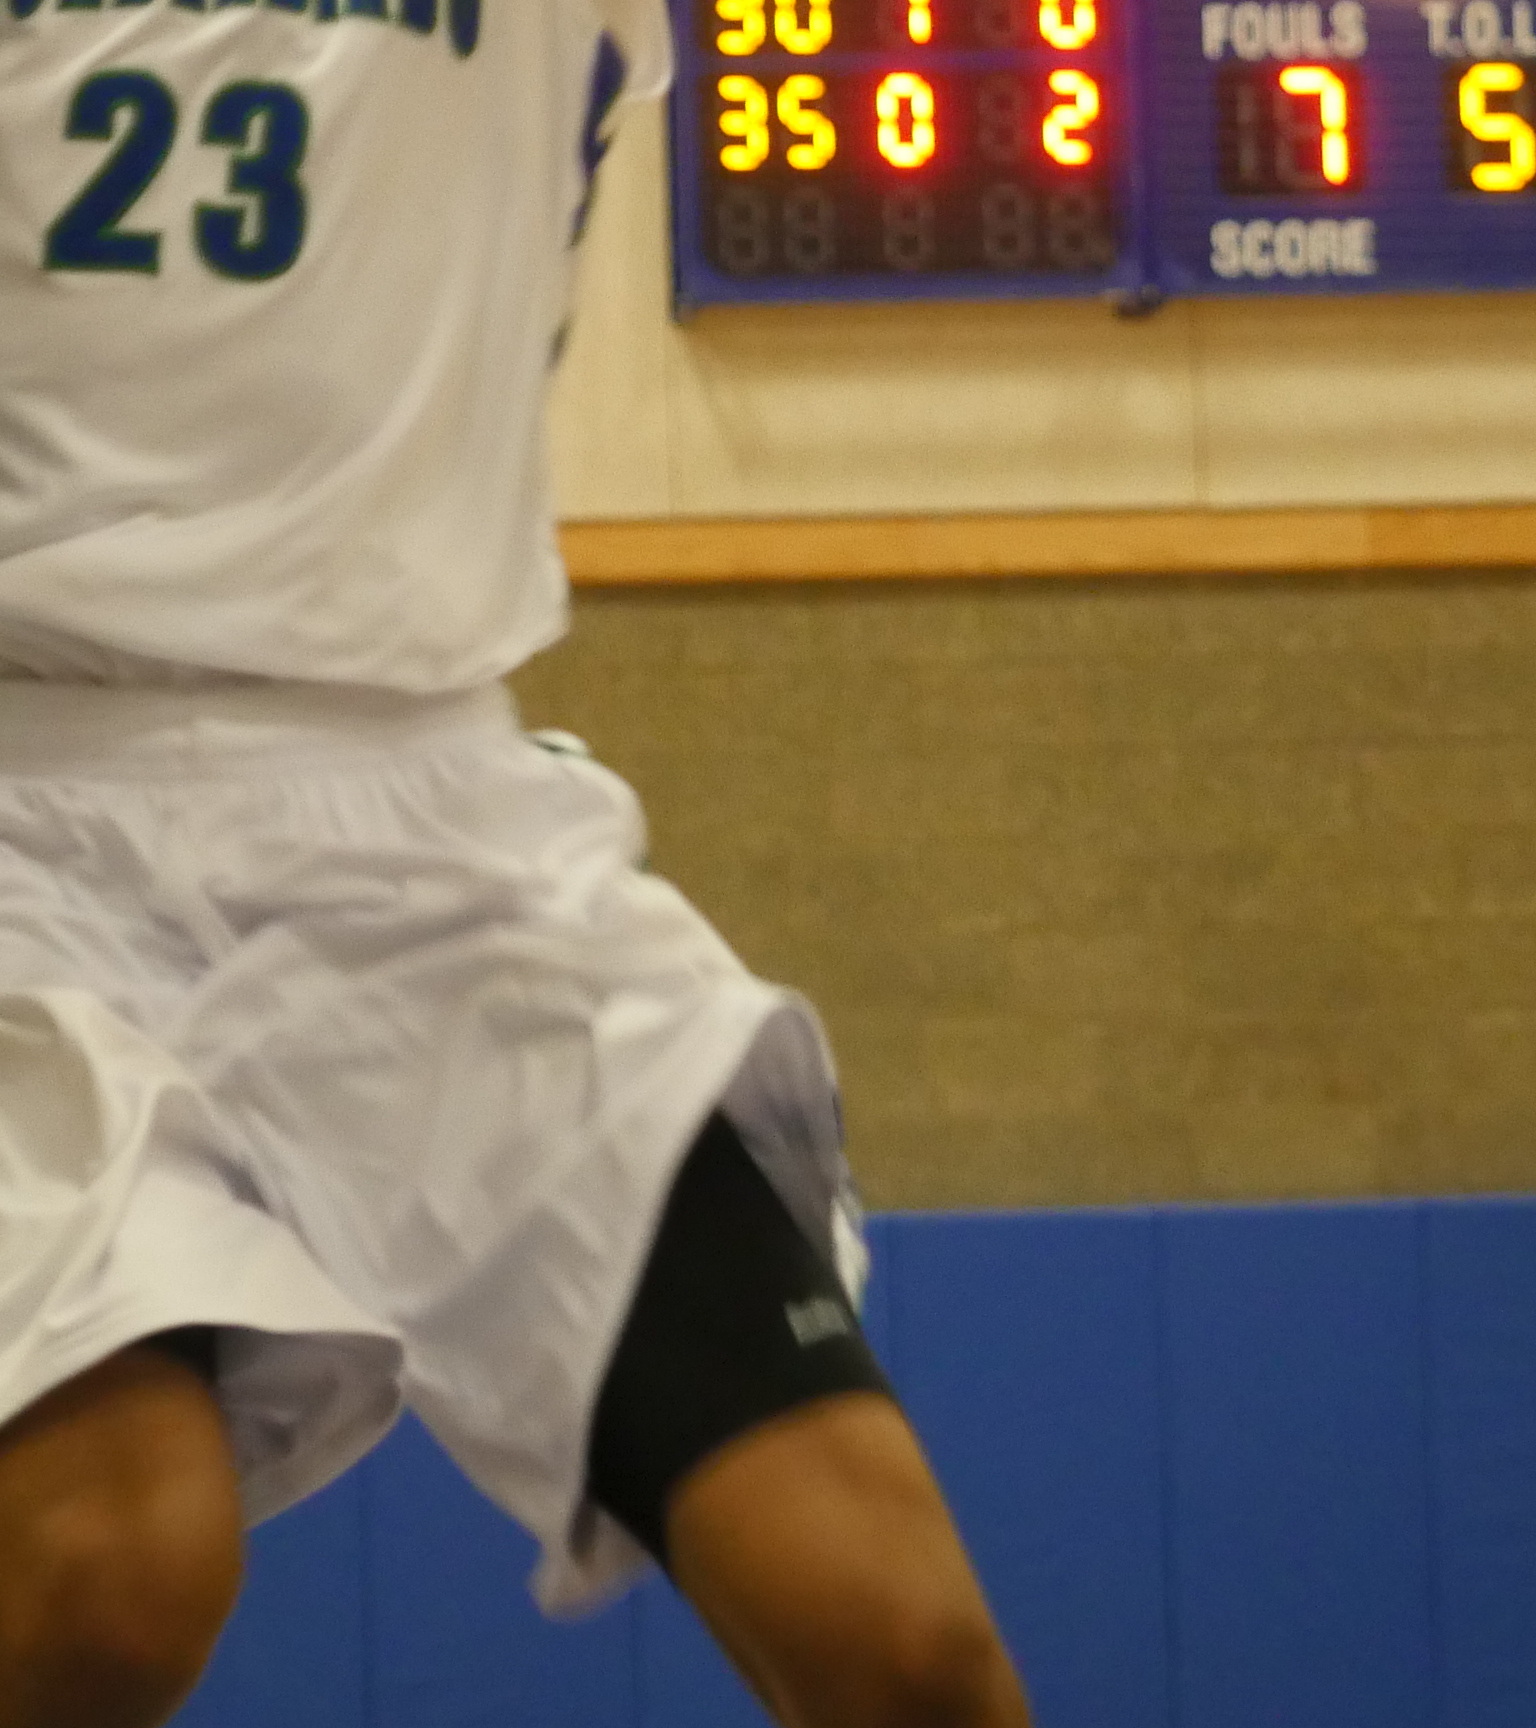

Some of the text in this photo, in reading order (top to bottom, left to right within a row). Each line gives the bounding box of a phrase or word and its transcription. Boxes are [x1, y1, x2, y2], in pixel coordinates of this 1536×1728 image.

[1201, 0, 1369, 61] FOULS
[717, 68, 1101, 171] 35 0 2
[1278, 65, 1350, 186] 7
[42, 69, 311, 280] 23
[1210, 218, 1377, 278] SCORE
